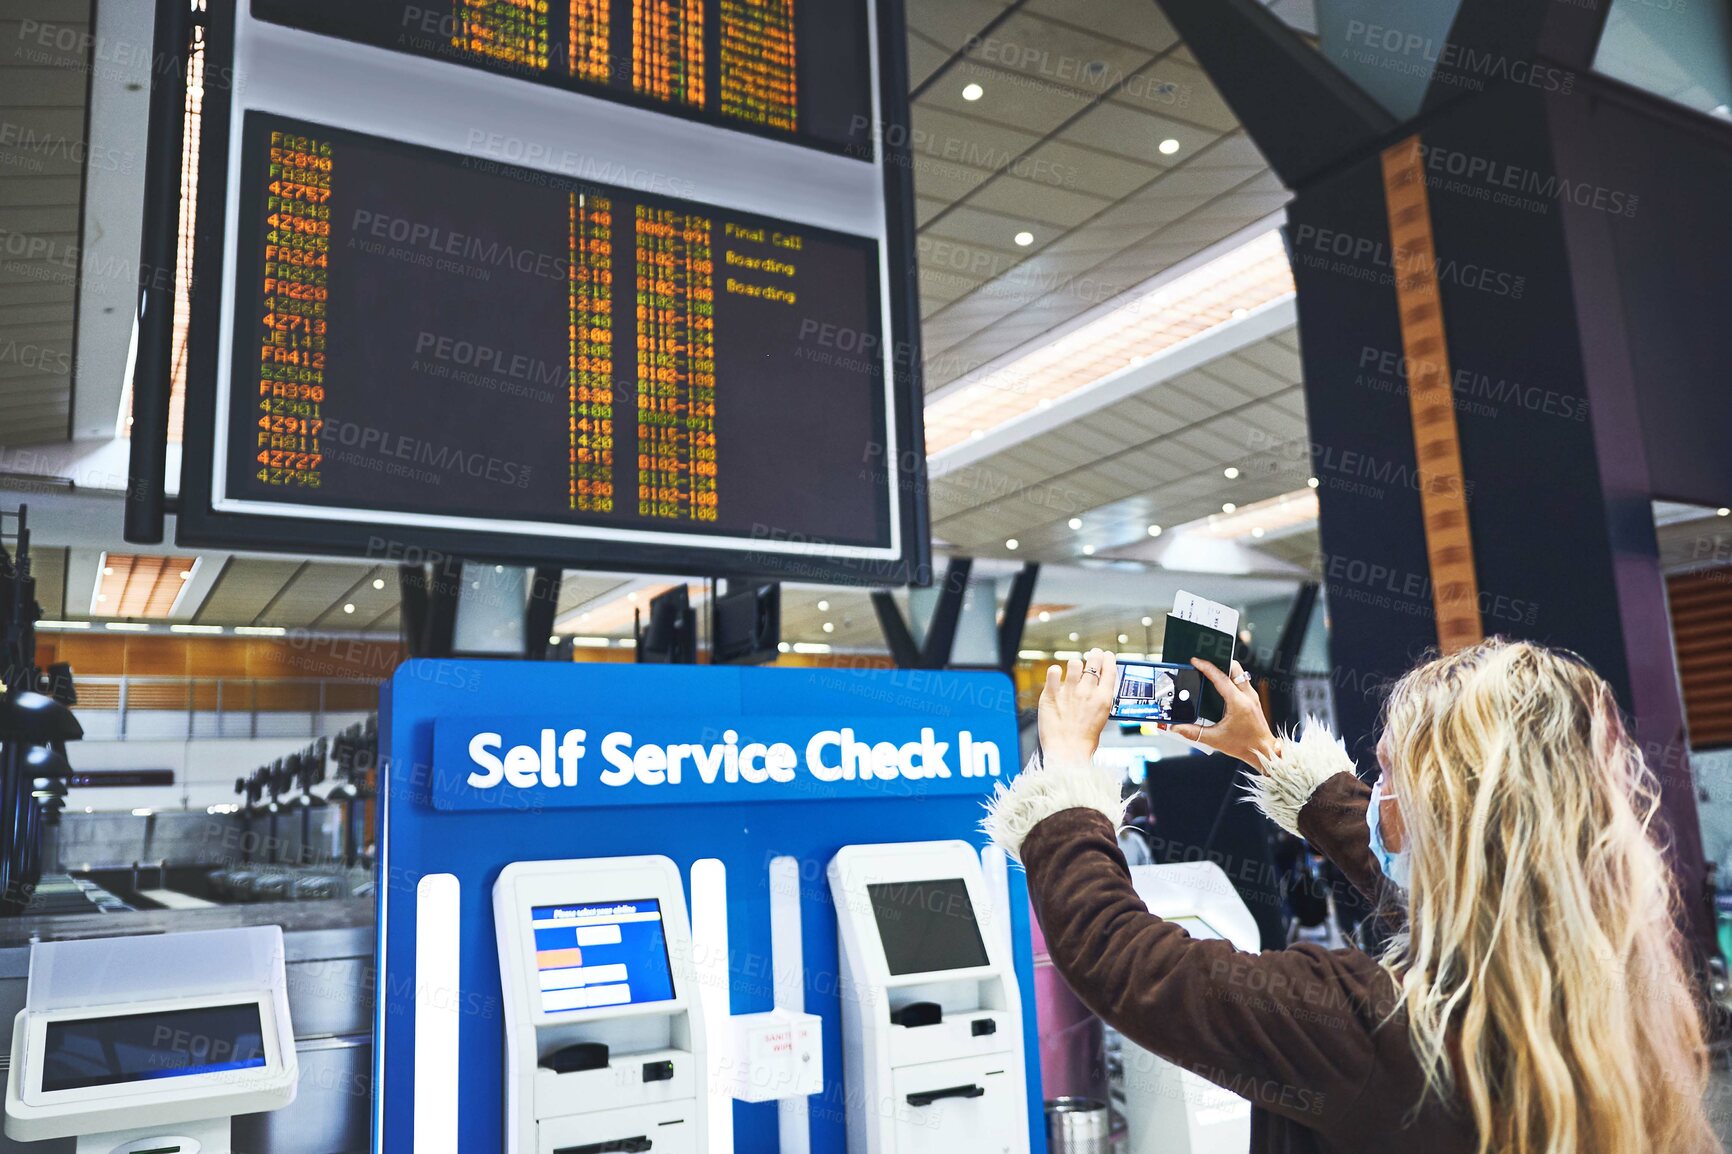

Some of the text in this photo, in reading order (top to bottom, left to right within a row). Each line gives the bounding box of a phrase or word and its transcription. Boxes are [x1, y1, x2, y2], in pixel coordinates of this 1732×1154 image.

[725, 223, 764, 242] Final
[773, 233, 803, 250] Call
[726, 250, 795, 277] Boarding
[726, 278, 796, 304] Boarding
[261, 345, 326, 369] FA412
[258, 415, 323, 436] 4Z917
[257, 449, 322, 470] 4Z727
[467, 727, 1001, 788] Self Service Check In
